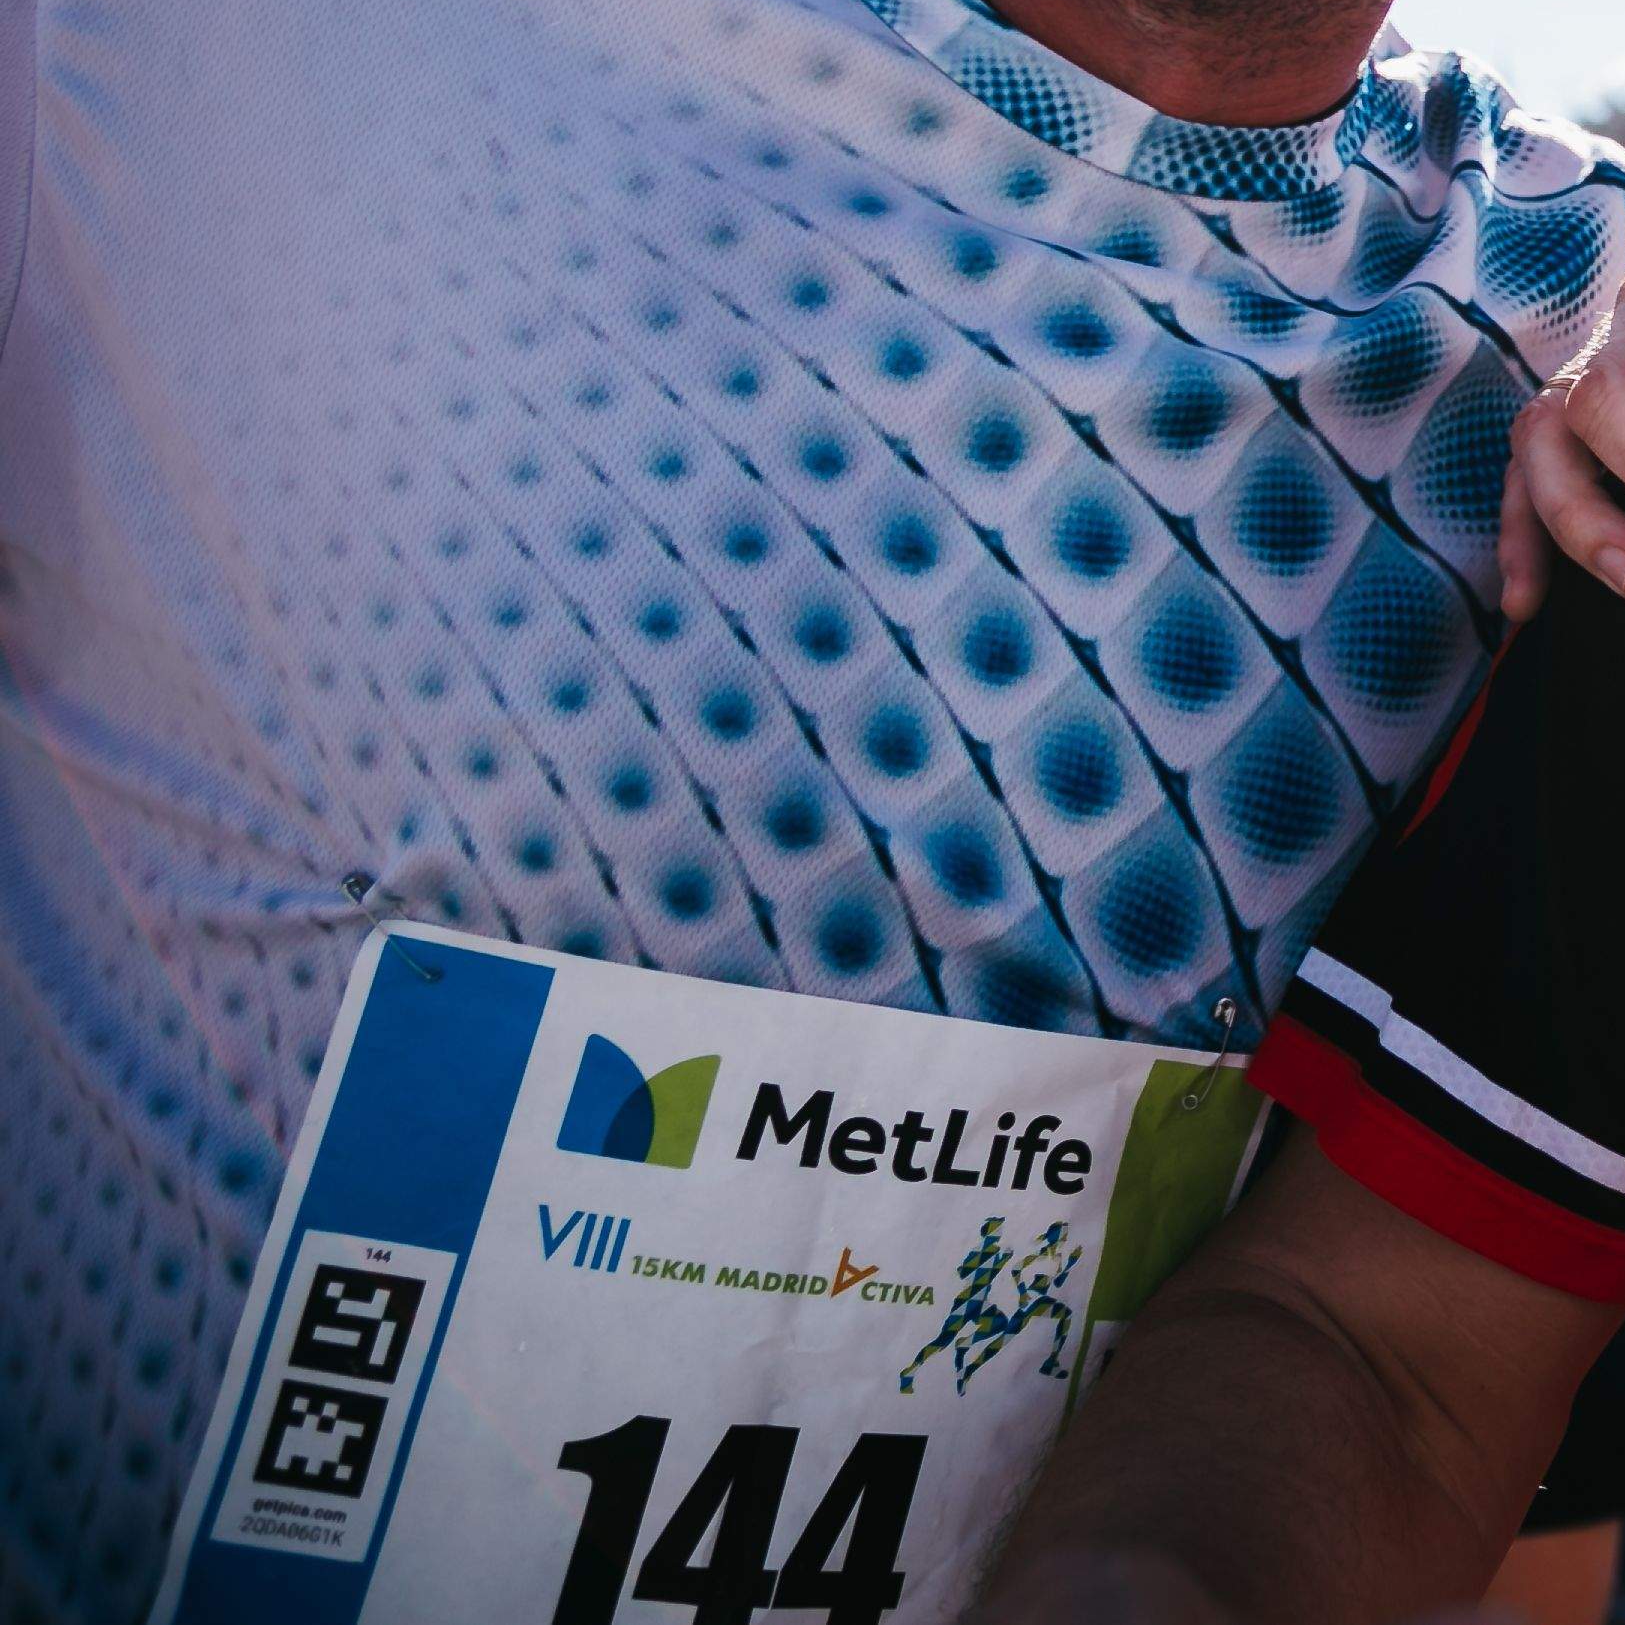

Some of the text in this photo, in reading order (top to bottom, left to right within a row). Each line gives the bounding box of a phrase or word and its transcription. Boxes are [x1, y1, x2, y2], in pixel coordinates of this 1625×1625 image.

[736, 1081, 1093, 1196] MetLife
[366, 1247, 392, 1263] 144
[538, 1204, 936, 1306] VIII 15KM MADRID ACTIVA
[252, 1498, 348, 1524] getpica.com
[550, 1413, 929, 1625] 144
